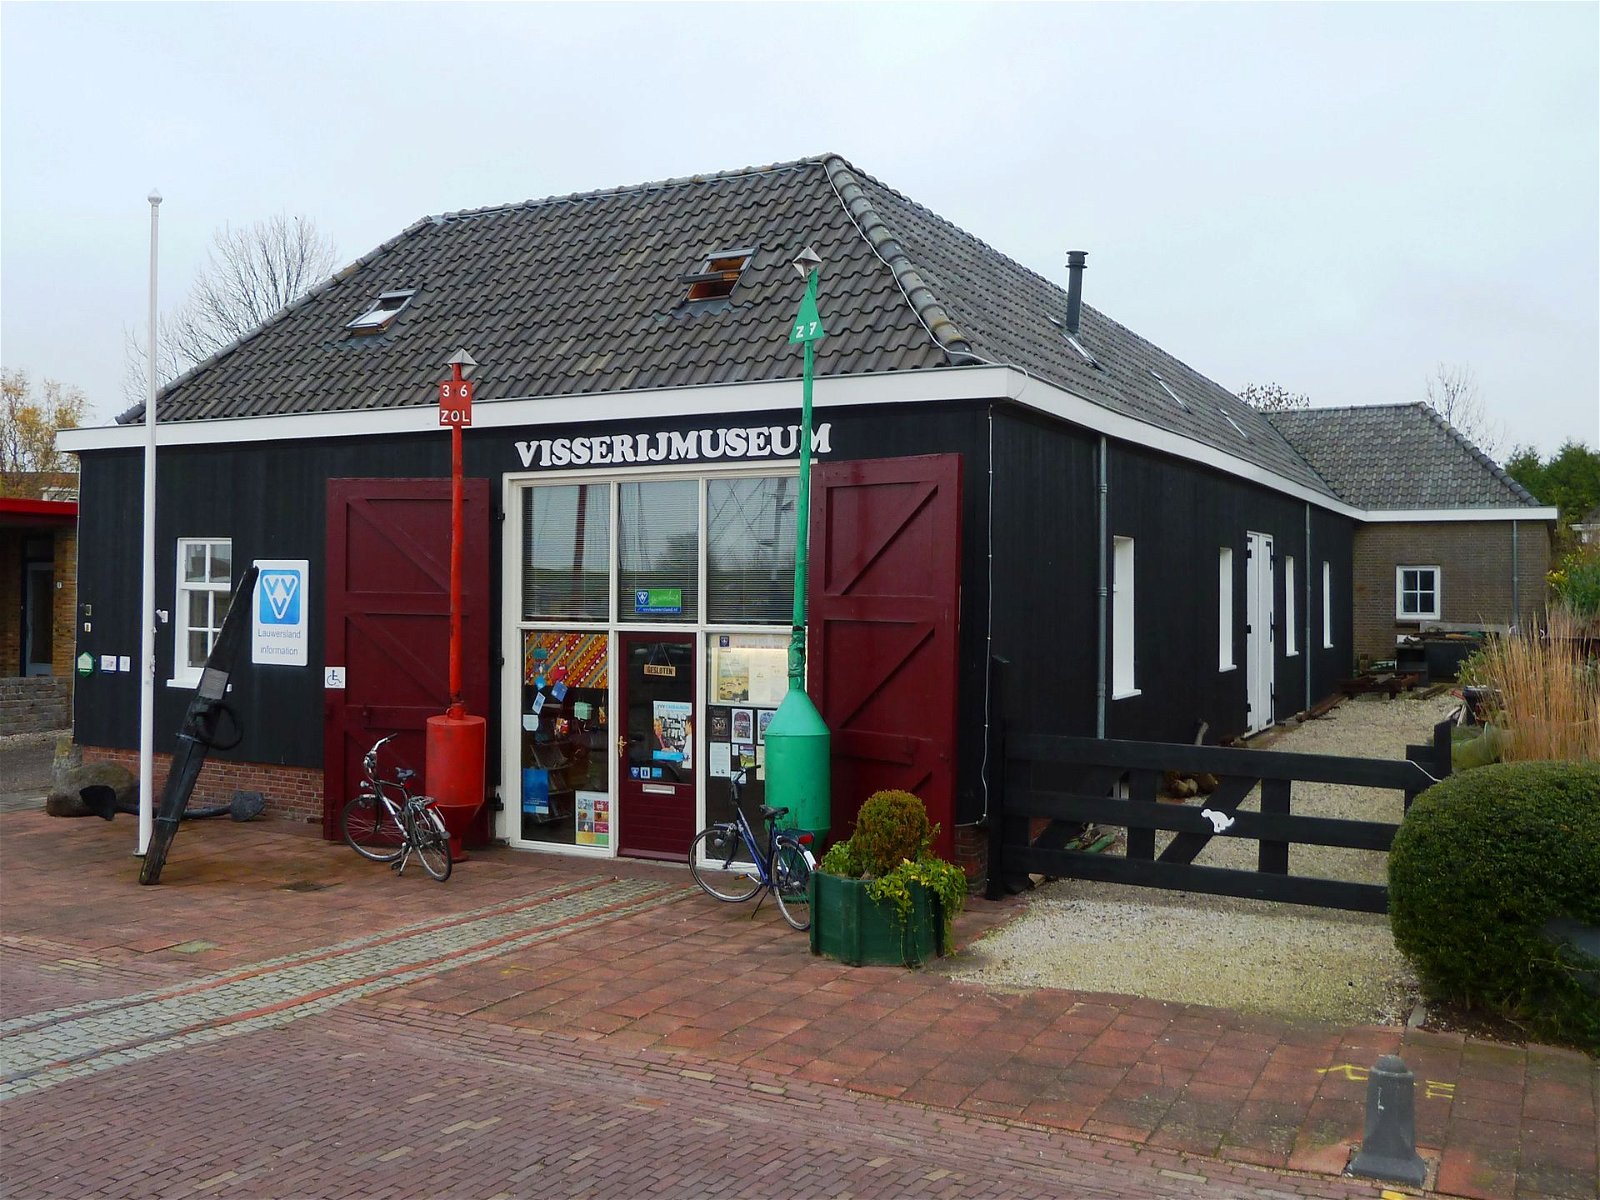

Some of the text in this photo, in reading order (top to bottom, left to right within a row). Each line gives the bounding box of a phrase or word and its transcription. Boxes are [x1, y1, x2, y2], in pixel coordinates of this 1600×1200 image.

[440, 409, 470, 423] ZOL
[514, 422, 832, 468] VISSERIJMUSEUM
[257, 629, 301, 639] Lauwersland
[260, 646, 299, 656] information
[646, 666, 673, 675] GESLOTEN
